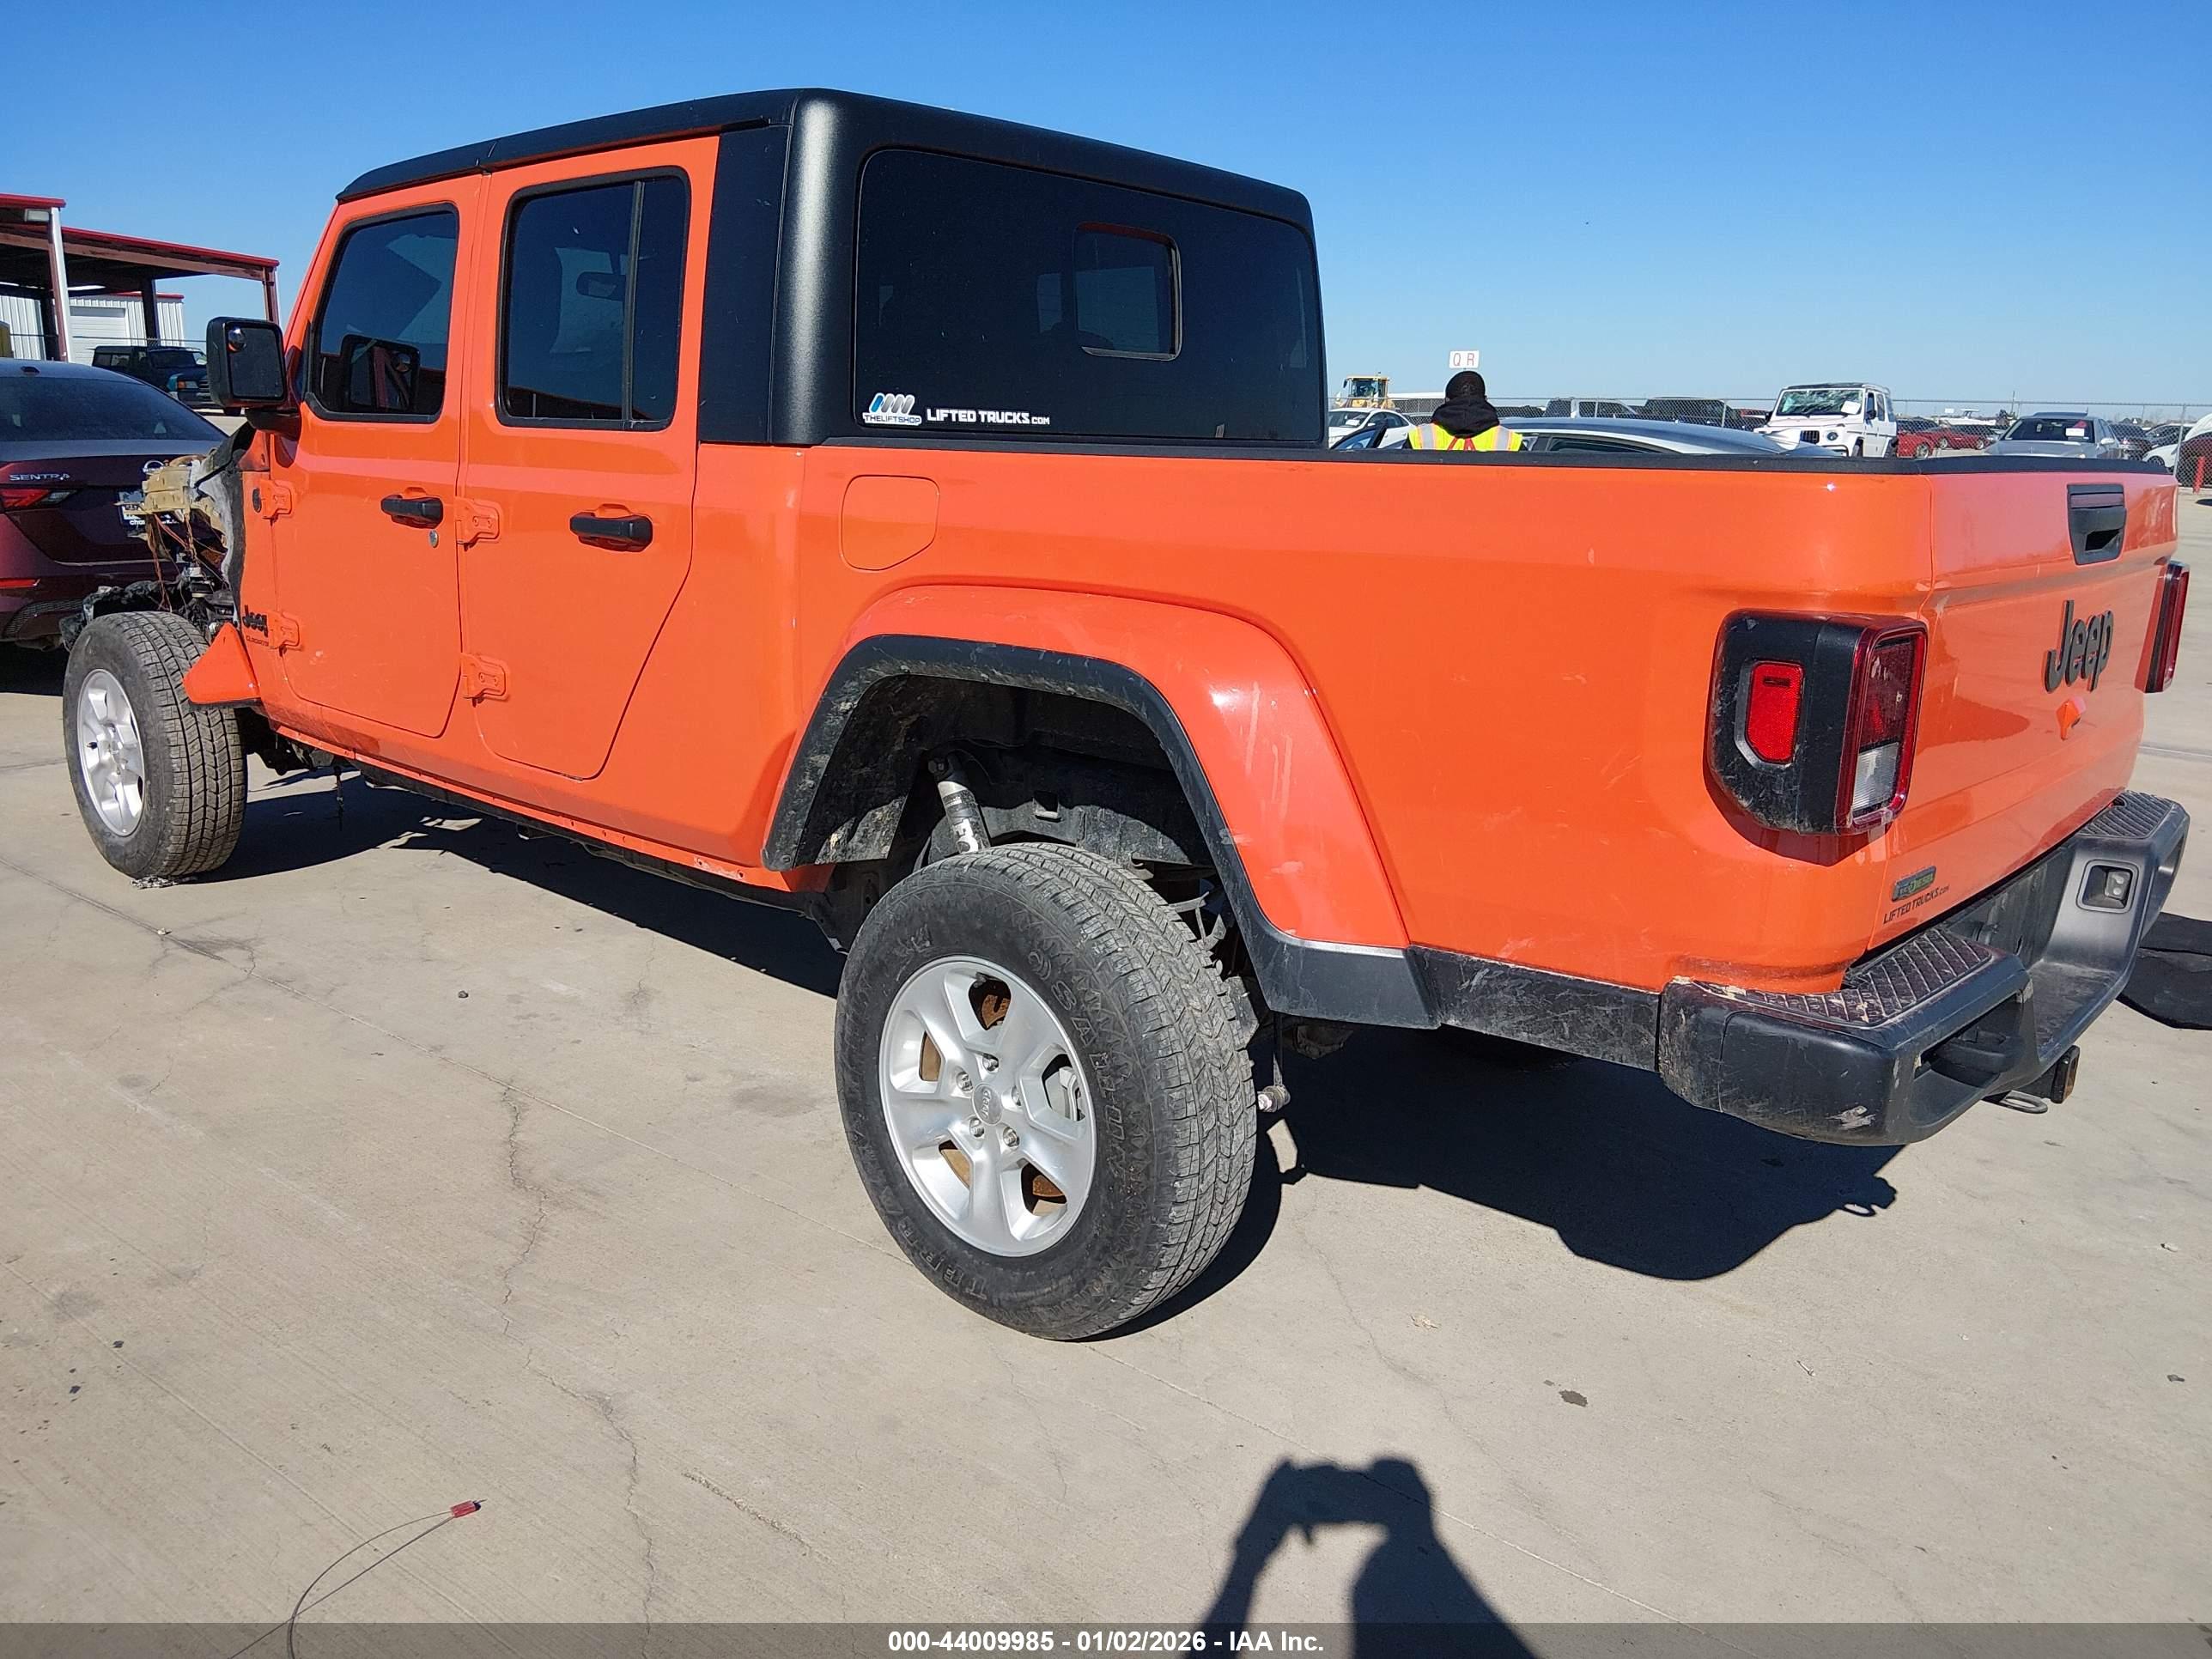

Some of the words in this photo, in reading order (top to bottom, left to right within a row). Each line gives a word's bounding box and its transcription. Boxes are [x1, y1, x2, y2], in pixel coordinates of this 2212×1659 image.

[927, 409, 976, 422] LIFTED
[242, 605, 269, 638] Jeep
[2042, 599, 2114, 694] Jeep
[1883, 902, 1912, 924] LIFTED
